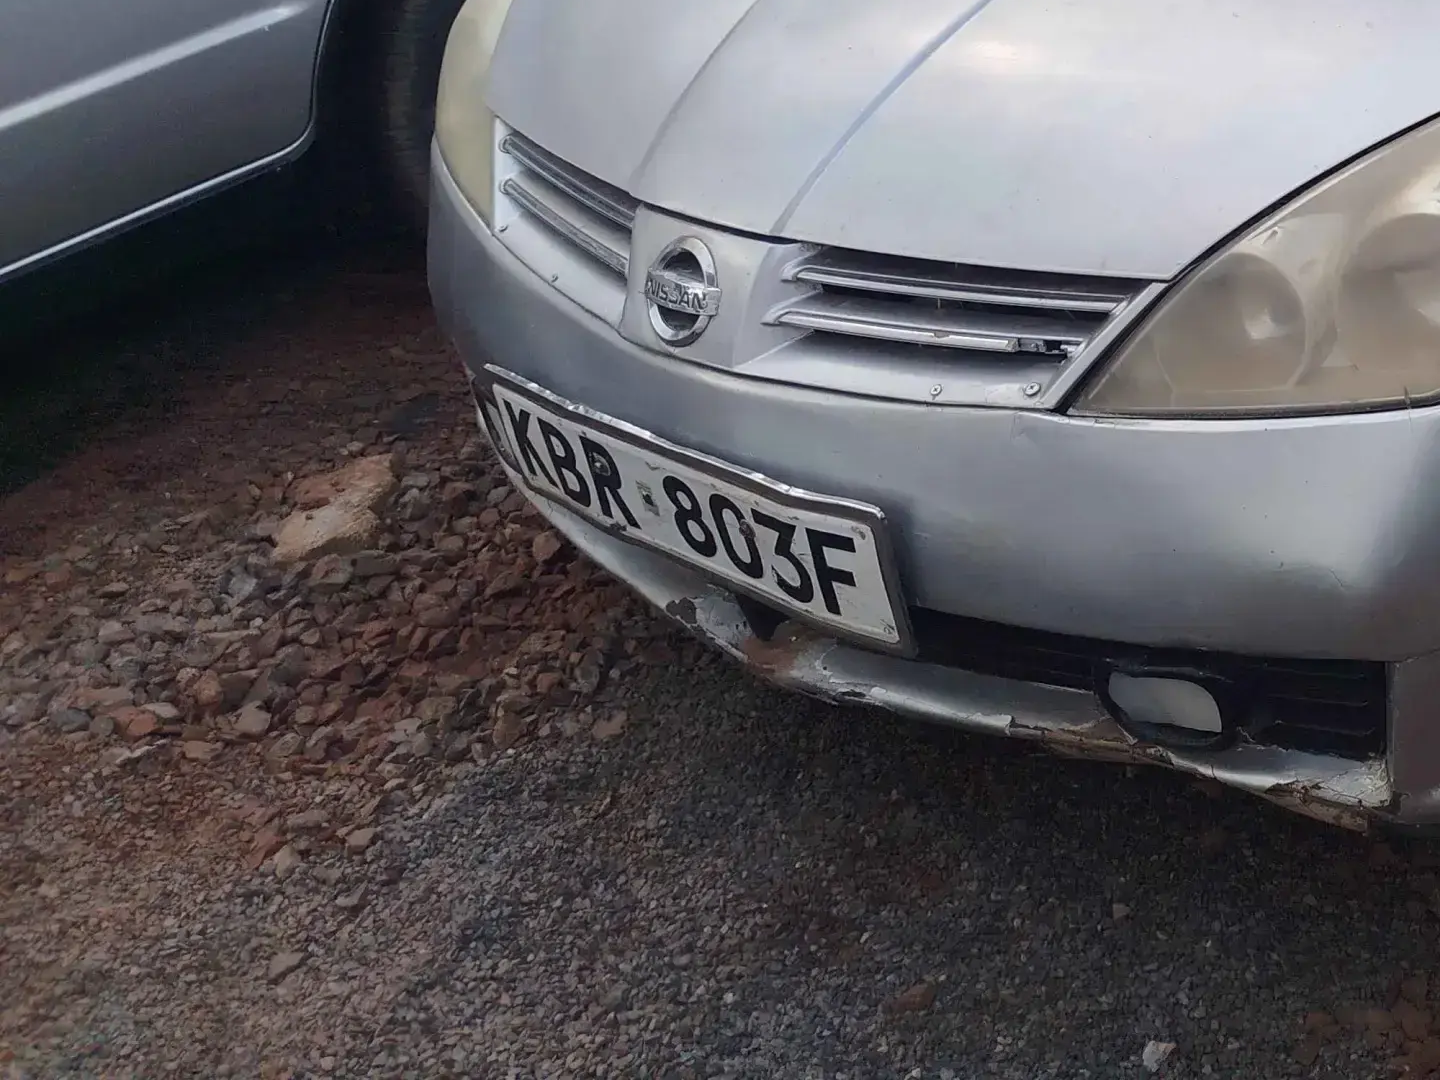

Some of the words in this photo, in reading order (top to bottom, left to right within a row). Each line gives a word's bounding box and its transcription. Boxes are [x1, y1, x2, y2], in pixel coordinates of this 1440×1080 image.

[645, 278, 709, 312] NISSAN
[503, 399, 641, 529] KBR
[663, 475, 857, 616] 803F
